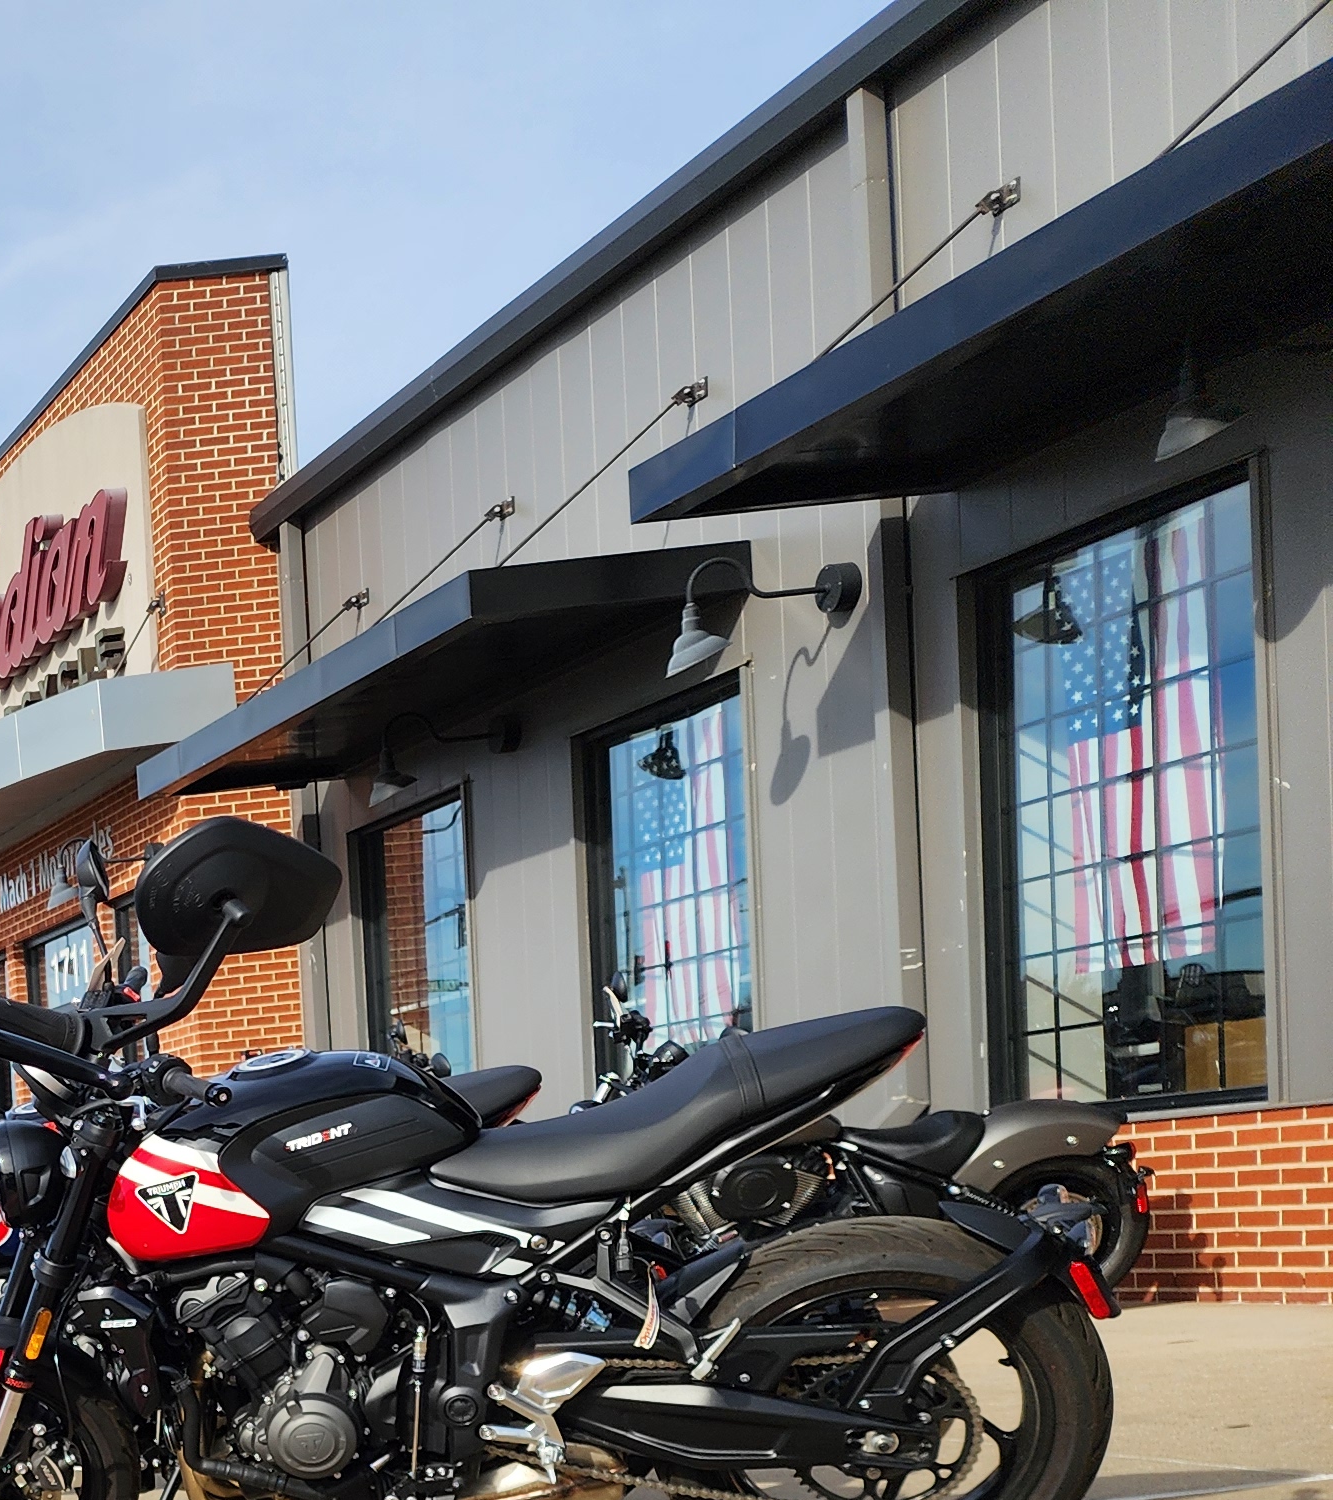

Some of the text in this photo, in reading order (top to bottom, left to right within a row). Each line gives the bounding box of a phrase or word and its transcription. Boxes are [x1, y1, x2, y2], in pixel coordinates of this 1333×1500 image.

[0, 862, 29, 914] Mach
[50, 939, 89, 994] 1711
[285, 1122, 352, 1152] TRIDENT
[146, 1179, 186, 1196] TRIUMPH
